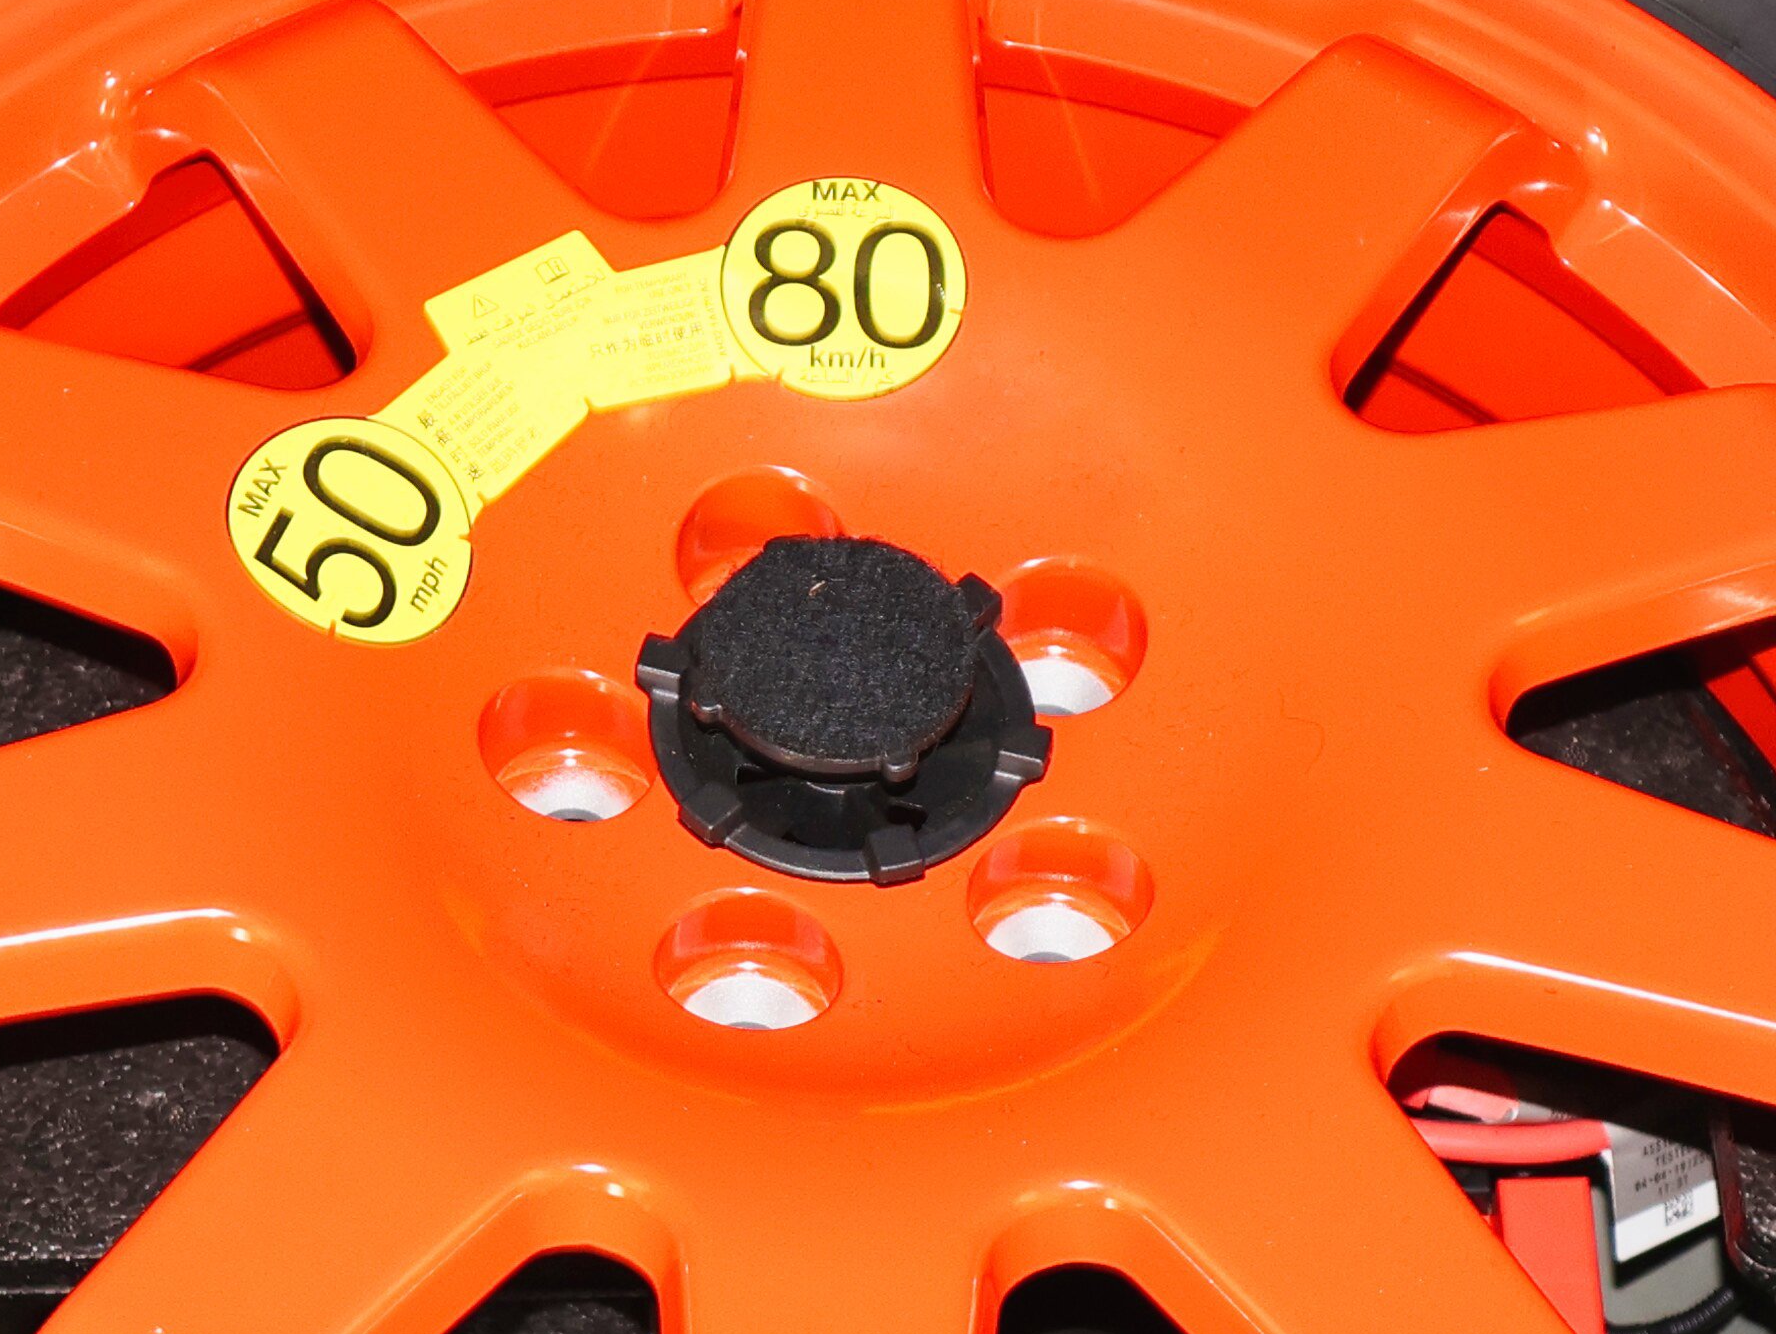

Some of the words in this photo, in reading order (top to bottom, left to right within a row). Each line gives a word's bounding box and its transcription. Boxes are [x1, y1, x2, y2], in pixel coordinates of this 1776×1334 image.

[812, 181, 882, 202] MAX
[749, 218, 946, 348] 80
[810, 346, 886, 368] km/h
[238, 458, 286, 519] MAX
[254, 437, 442, 628] 50
[410, 555, 449, 614] mph
